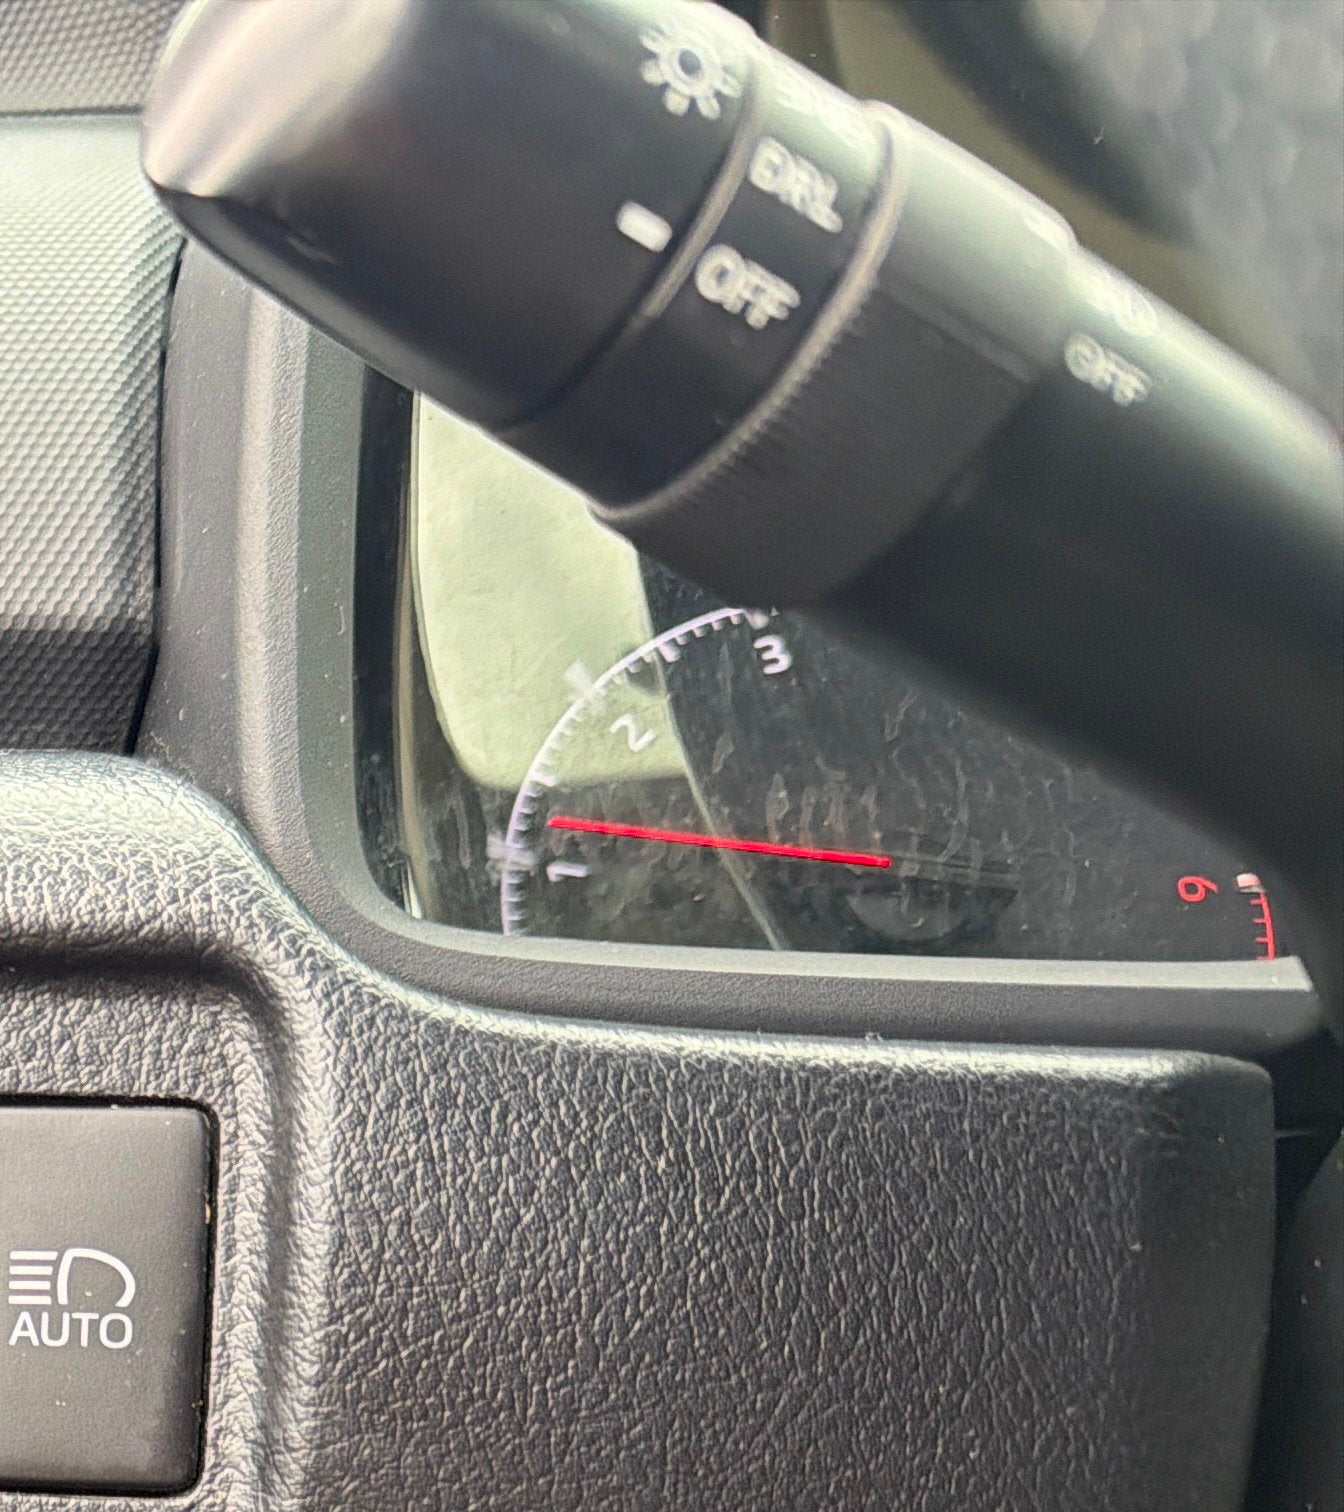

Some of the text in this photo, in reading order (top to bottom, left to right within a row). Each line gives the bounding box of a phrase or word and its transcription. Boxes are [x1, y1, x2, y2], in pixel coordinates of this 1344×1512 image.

[695, 244, 801, 330] OFF
[755, 635, 793, 675] 3
[610, 712, 656, 751] 2
[546, 860, 590, 883] 1
[1178, 876, 1219, 903] 6
[8, 1310, 134, 1350] AUTO
